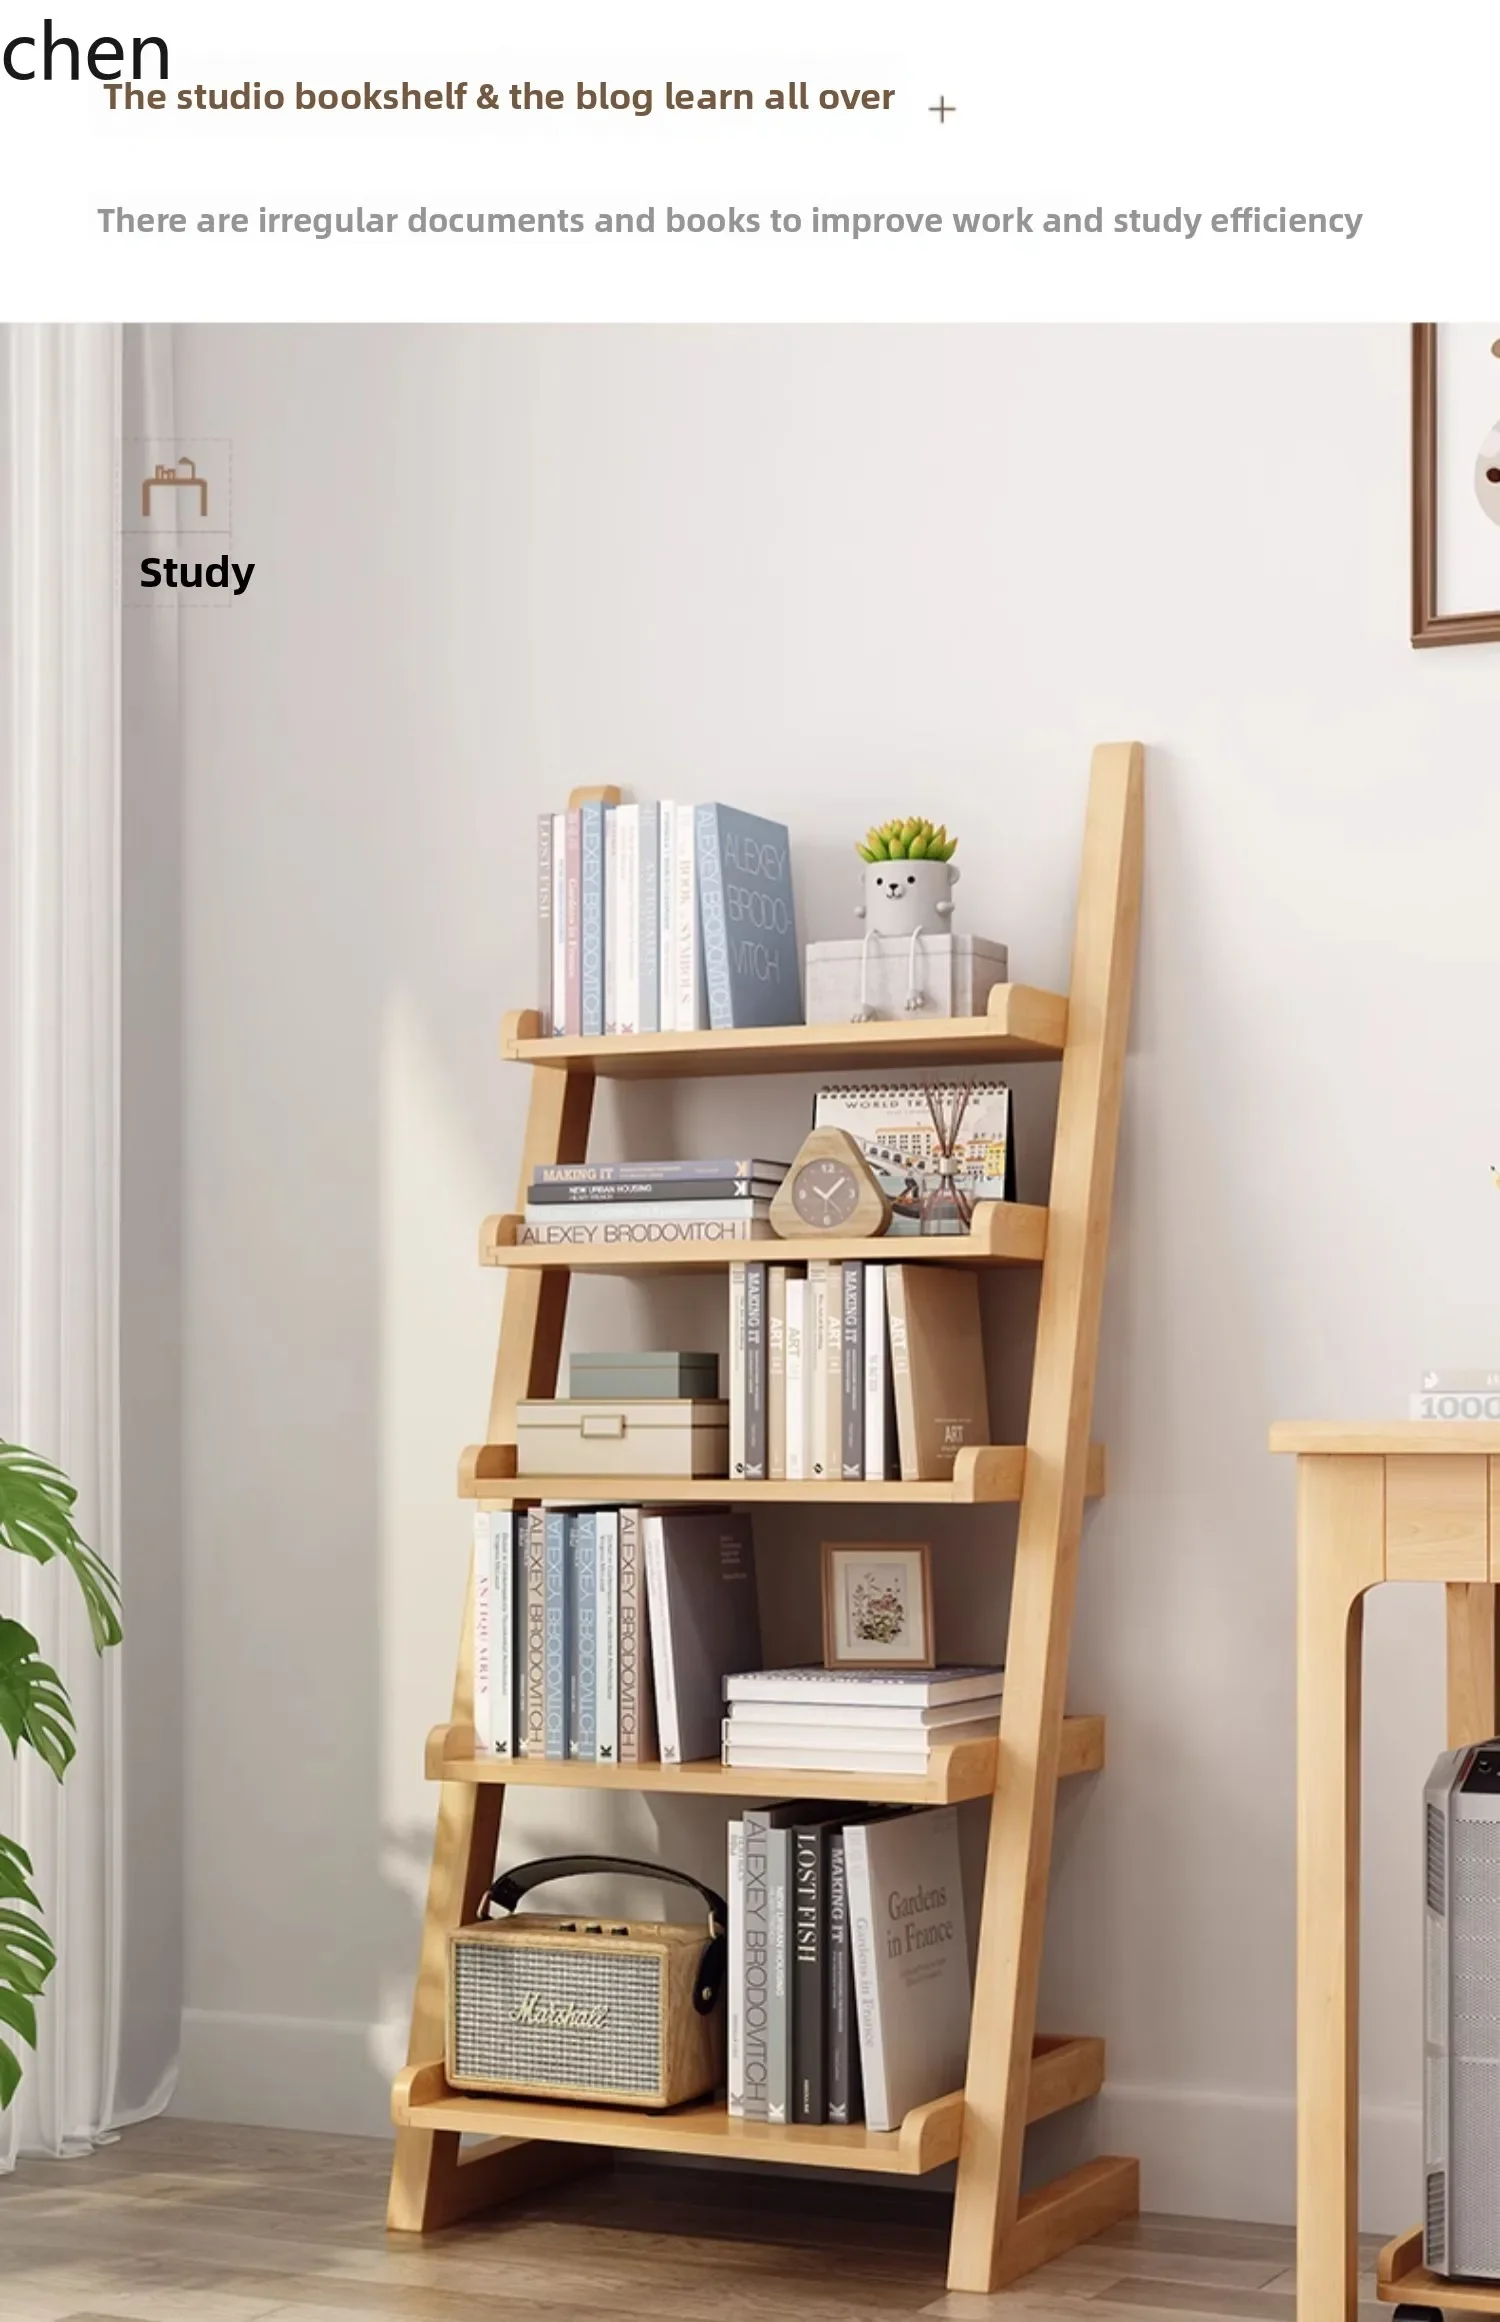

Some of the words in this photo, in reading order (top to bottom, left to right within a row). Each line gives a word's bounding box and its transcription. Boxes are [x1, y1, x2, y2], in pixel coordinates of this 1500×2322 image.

[583, 807, 600, 888] ALEXEY
[697, 809, 720, 885] ALEXEY
[725, 833, 786, 881] ALEXEY
[583, 893, 600, 1026] BRODOVITCH
[703, 891, 732, 1020] BRODOVITCH
[731, 936, 781, 983] VITCH
[844, 1100, 899, 1109] WORLD
[543, 1168, 597, 1181] MAKING
[600, 1167, 614, 1179] IT
[821, 1163, 835, 1173] 12
[522, 1225, 598, 1245] ALEXEY
[604, 1222, 735, 1243] BRODOVITCH
[748, 1272, 760, 1326] MAKING
[845, 1270, 857, 1325] MAKING
[748, 1328, 760, 1344] IT
[769, 1316, 783, 1350] ART
[788, 1327, 800, 1358] ART
[845, 1328, 857, 1343] IT
[890, 1315, 906, 1350] ART
[529, 1514, 544, 1597] ALEXEY
[621, 1515, 636, 1600] ALEXEY
[529, 1603, 544, 1743] BRODOVITCH
[621, 1606, 637, 1746] BRODOVITCH
[745, 1820, 768, 1922] ALEXEY
[797, 1833, 817, 1900] LOST
[831, 1848, 844, 1920] MAKING
[888, 1884, 947, 1921] Gardens
[797, 1906, 817, 1962] FISH
[831, 1924, 844, 1943] IT
[887, 1930, 902, 1958] in
[904, 1920, 953, 1953] France
[509, 1992, 609, 2029] Marshall
[745, 1930, 768, 2101] BRODOVITCH
